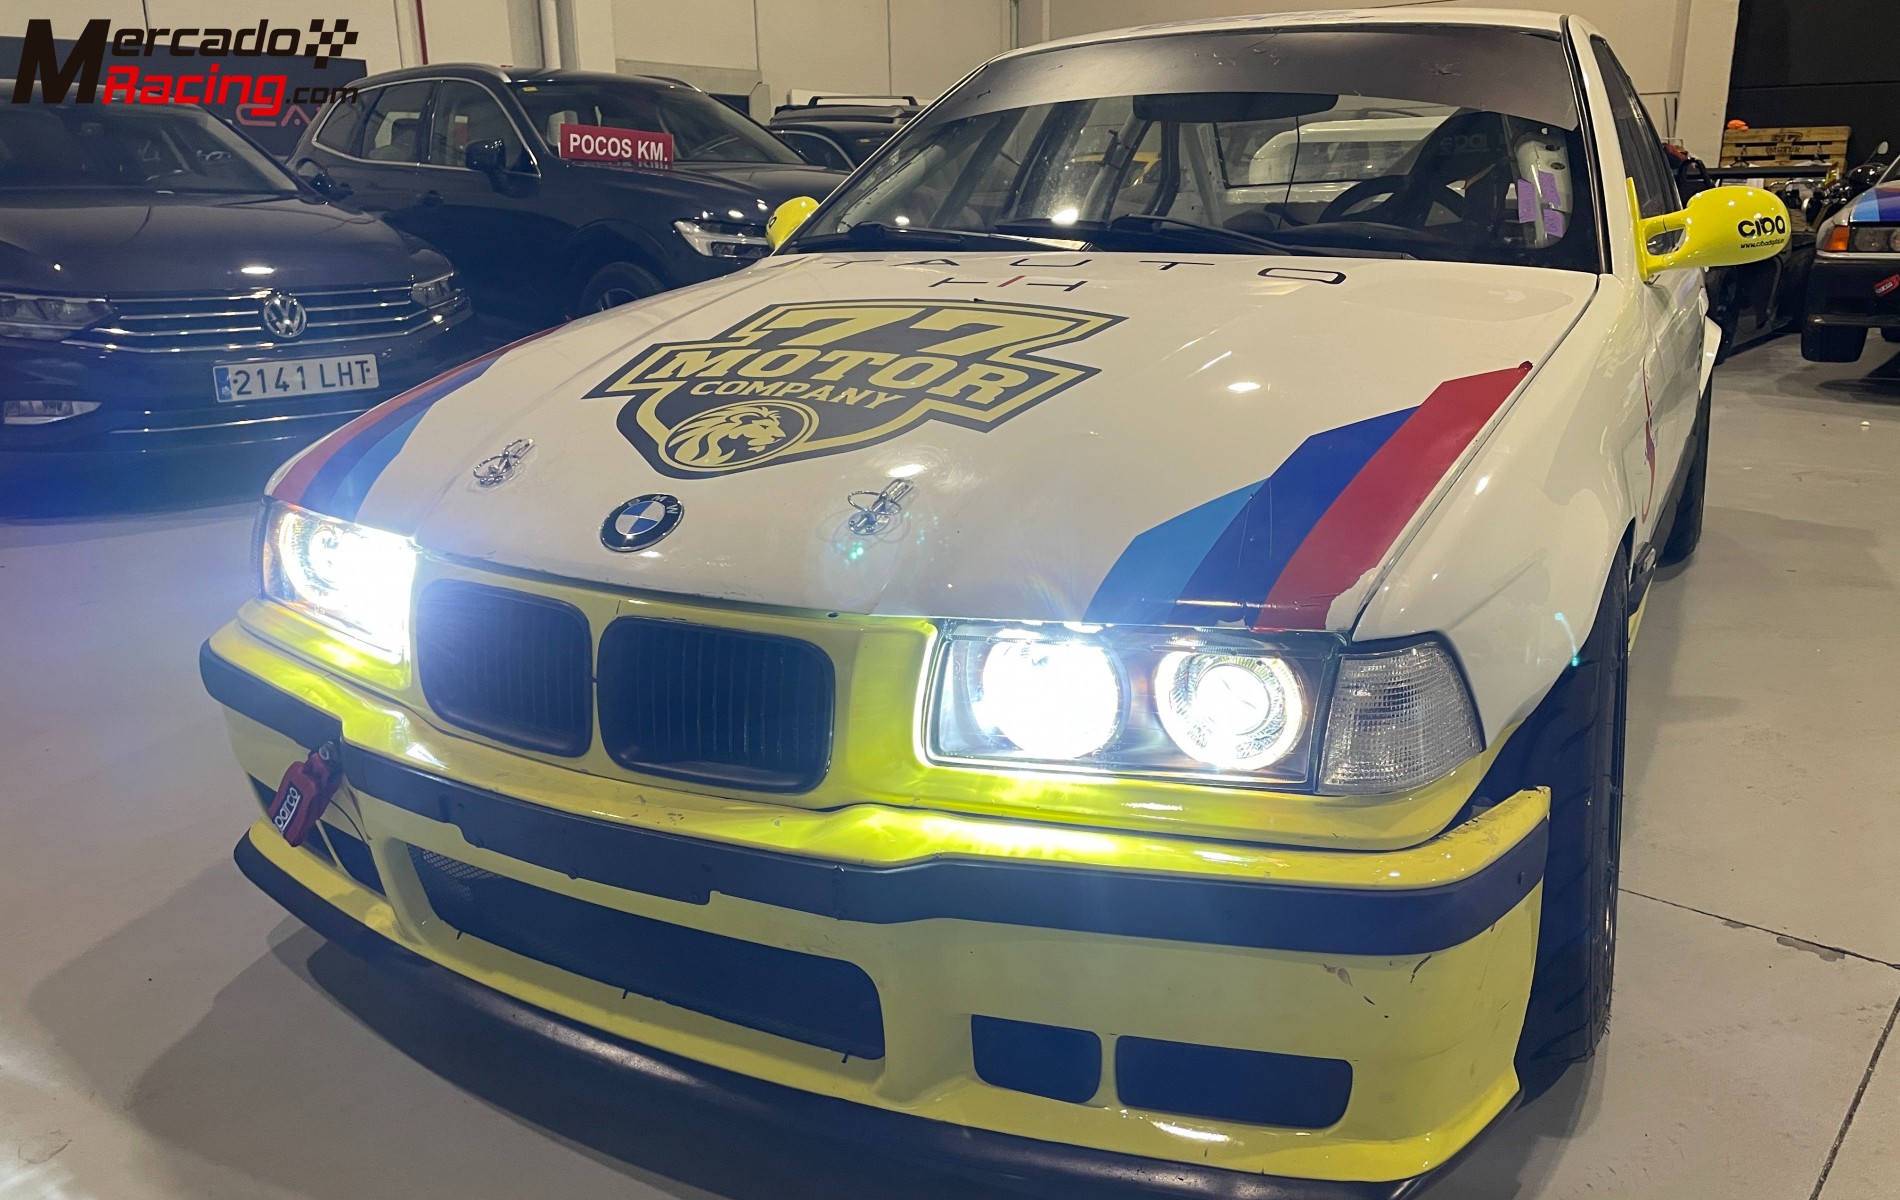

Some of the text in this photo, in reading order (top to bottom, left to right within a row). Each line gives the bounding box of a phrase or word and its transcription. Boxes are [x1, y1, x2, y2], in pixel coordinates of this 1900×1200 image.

[236, 104, 320, 127] CA
[570, 133, 668, 162] POCOS KM.
[764, 308, 1078, 356] 77
[234, 360, 369, 396] 2141 LHT
[646, 349, 1030, 405] MOTOR
[690, 380, 905, 410] COMPANY
[274, 786, 301, 831] parco
